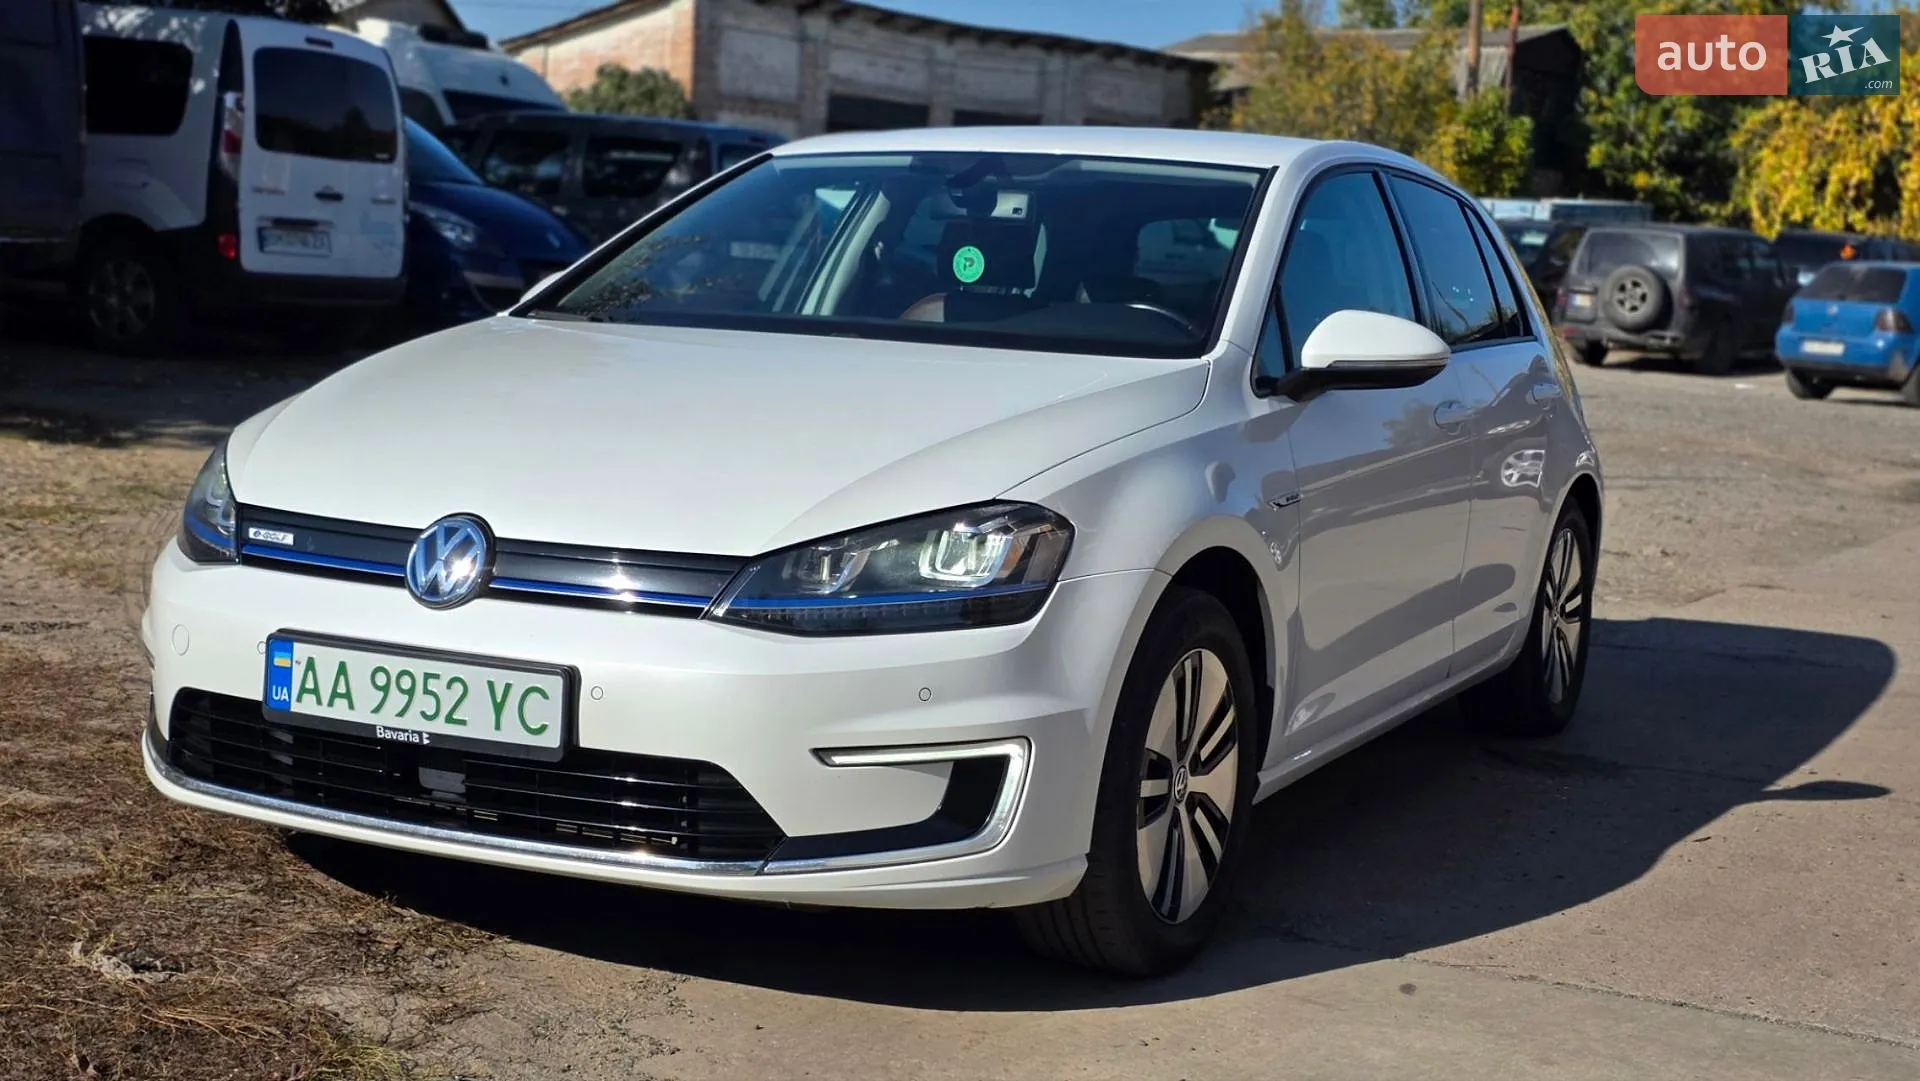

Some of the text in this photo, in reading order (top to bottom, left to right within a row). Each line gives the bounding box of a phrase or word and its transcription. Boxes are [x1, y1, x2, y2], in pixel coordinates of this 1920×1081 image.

[271, 685, 290, 702] UA
[295, 656, 550, 736] AA 9952 YC
[376, 725, 420, 743] Bavaria
